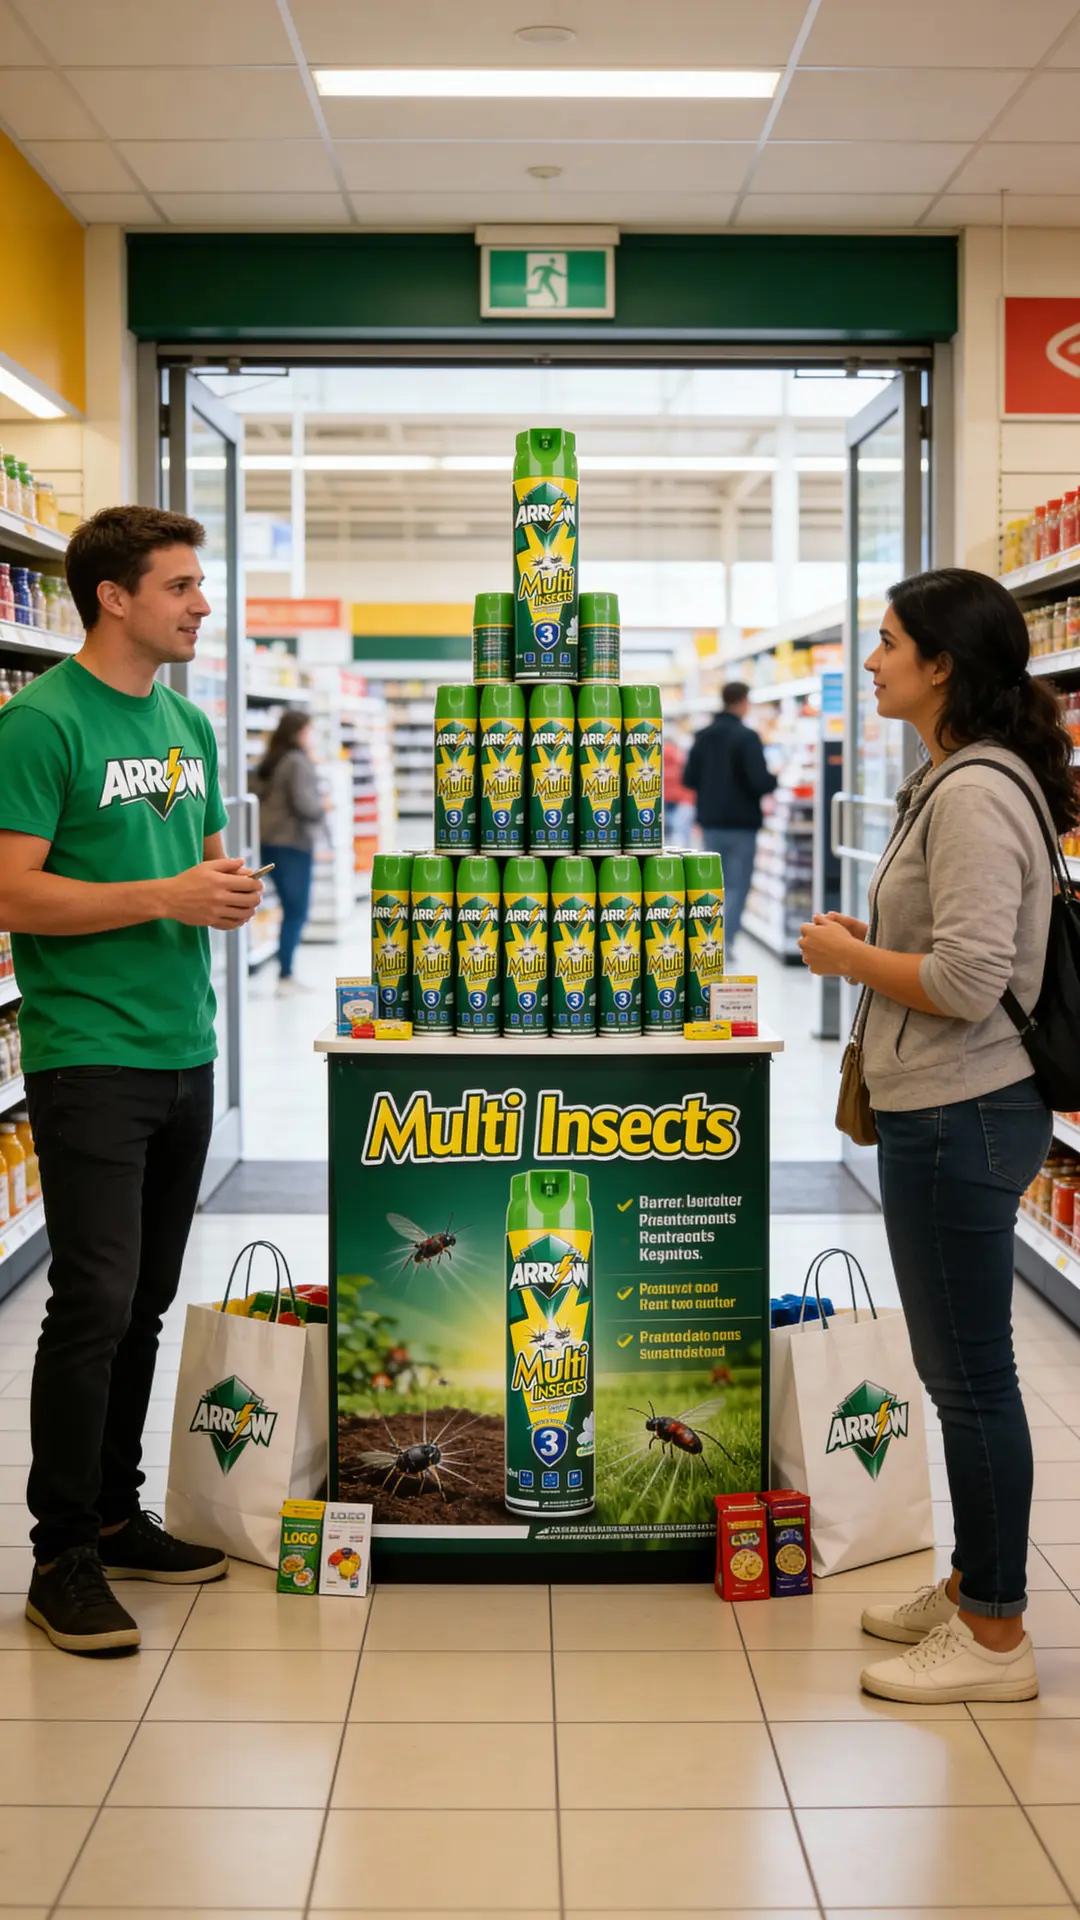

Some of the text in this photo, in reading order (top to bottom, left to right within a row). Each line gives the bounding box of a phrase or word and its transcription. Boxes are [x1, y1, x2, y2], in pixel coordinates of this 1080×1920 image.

[515, 504, 575, 527] ARROW
[519, 569, 575, 600] Multi
[535, 592, 573, 606] INSECTS
[540, 625, 554, 643] 3
[98, 758, 206, 809] ARROW
[450, 811, 458, 823] 3
[498, 811, 506, 824] 3
[548, 811, 557, 824] 3
[598, 811, 606, 824] 3
[642, 810, 651, 822] 3
[427, 992, 435, 1004] 3
[473, 993, 482, 1006] 3
[523, 994, 532, 1007] 3
[570, 993, 579, 1006] 3
[619, 993, 627, 1005] 3
[663, 991, 671, 1003] 3
[362, 1089, 740, 1164] Multi Insects
[509, 1262, 588, 1290] ARROW
[512, 1342, 588, 1390] Multi
[534, 1379, 586, 1401] INSECTS
[190, 1401, 278, 1447] ARROW
[827, 1402, 908, 1454] ARROW
[540, 1430, 559, 1456] 3
[284, 1532, 318, 1545] LOGO
